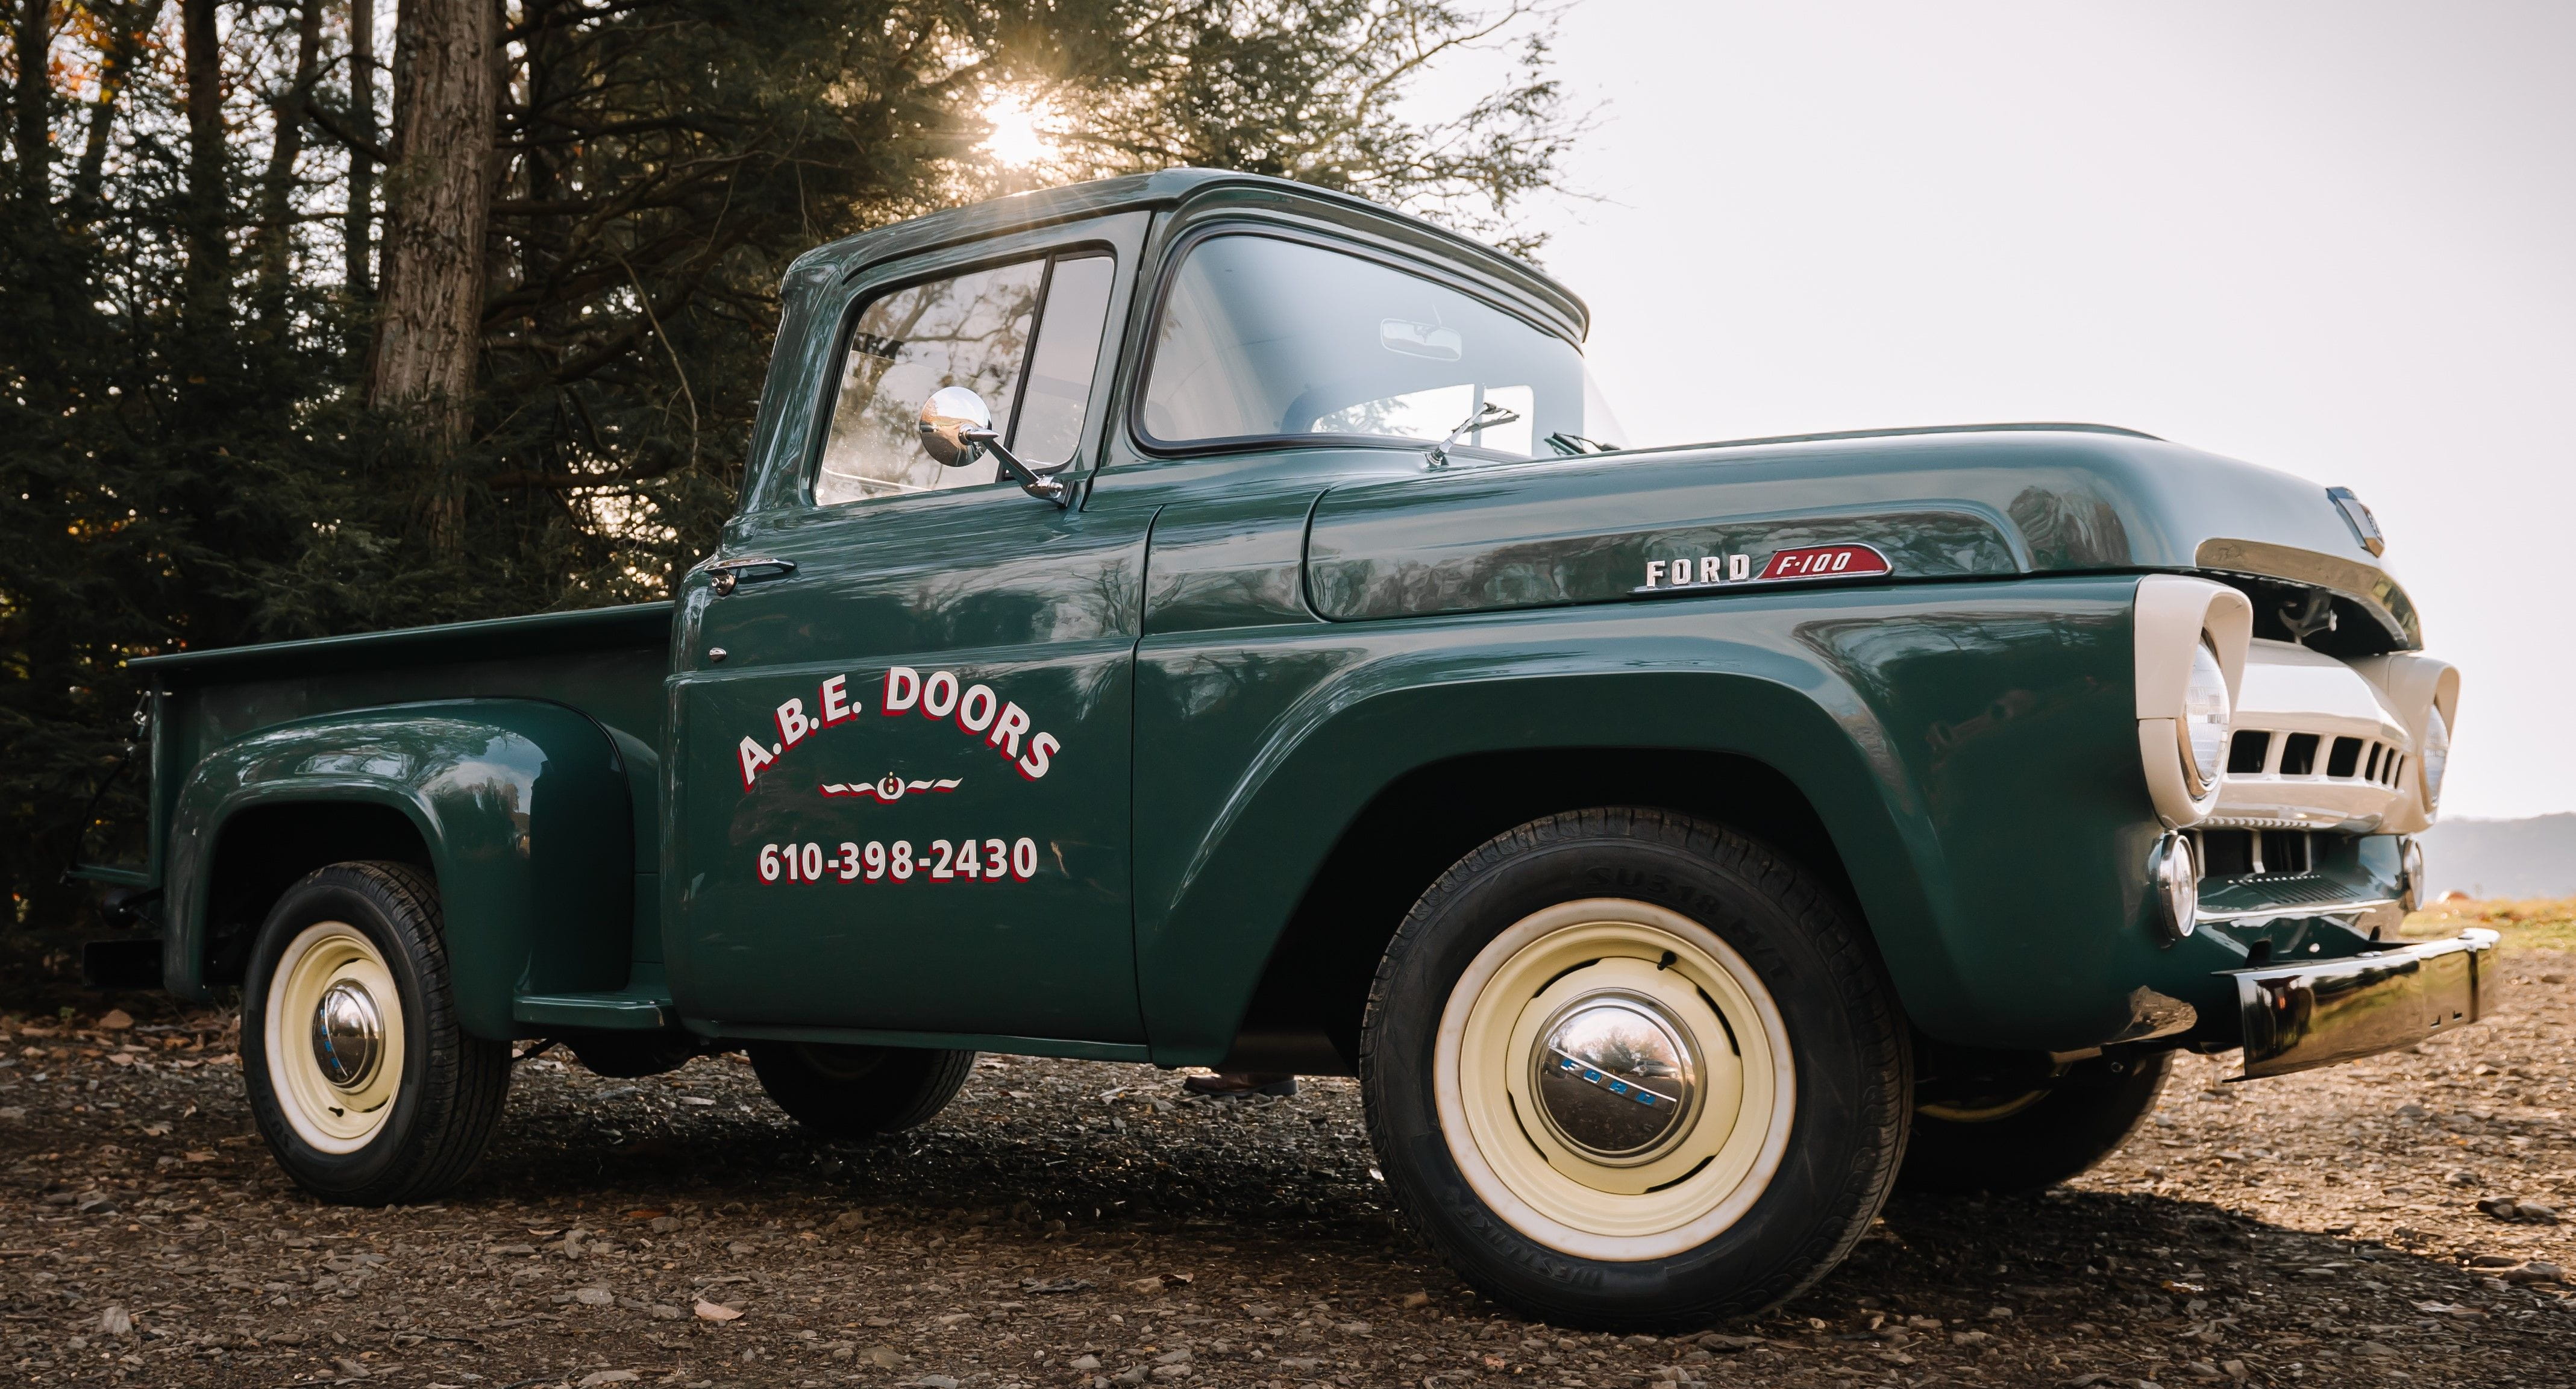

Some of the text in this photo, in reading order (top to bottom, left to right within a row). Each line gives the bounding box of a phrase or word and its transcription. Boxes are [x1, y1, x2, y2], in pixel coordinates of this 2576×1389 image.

[1646, 554, 1750, 588] FORD
[737, 666, 1061, 793] A.B.E. DOORS
[757, 836, 1038, 885] 610-398-2430
[1560, 1058, 1656, 1106] FORD
